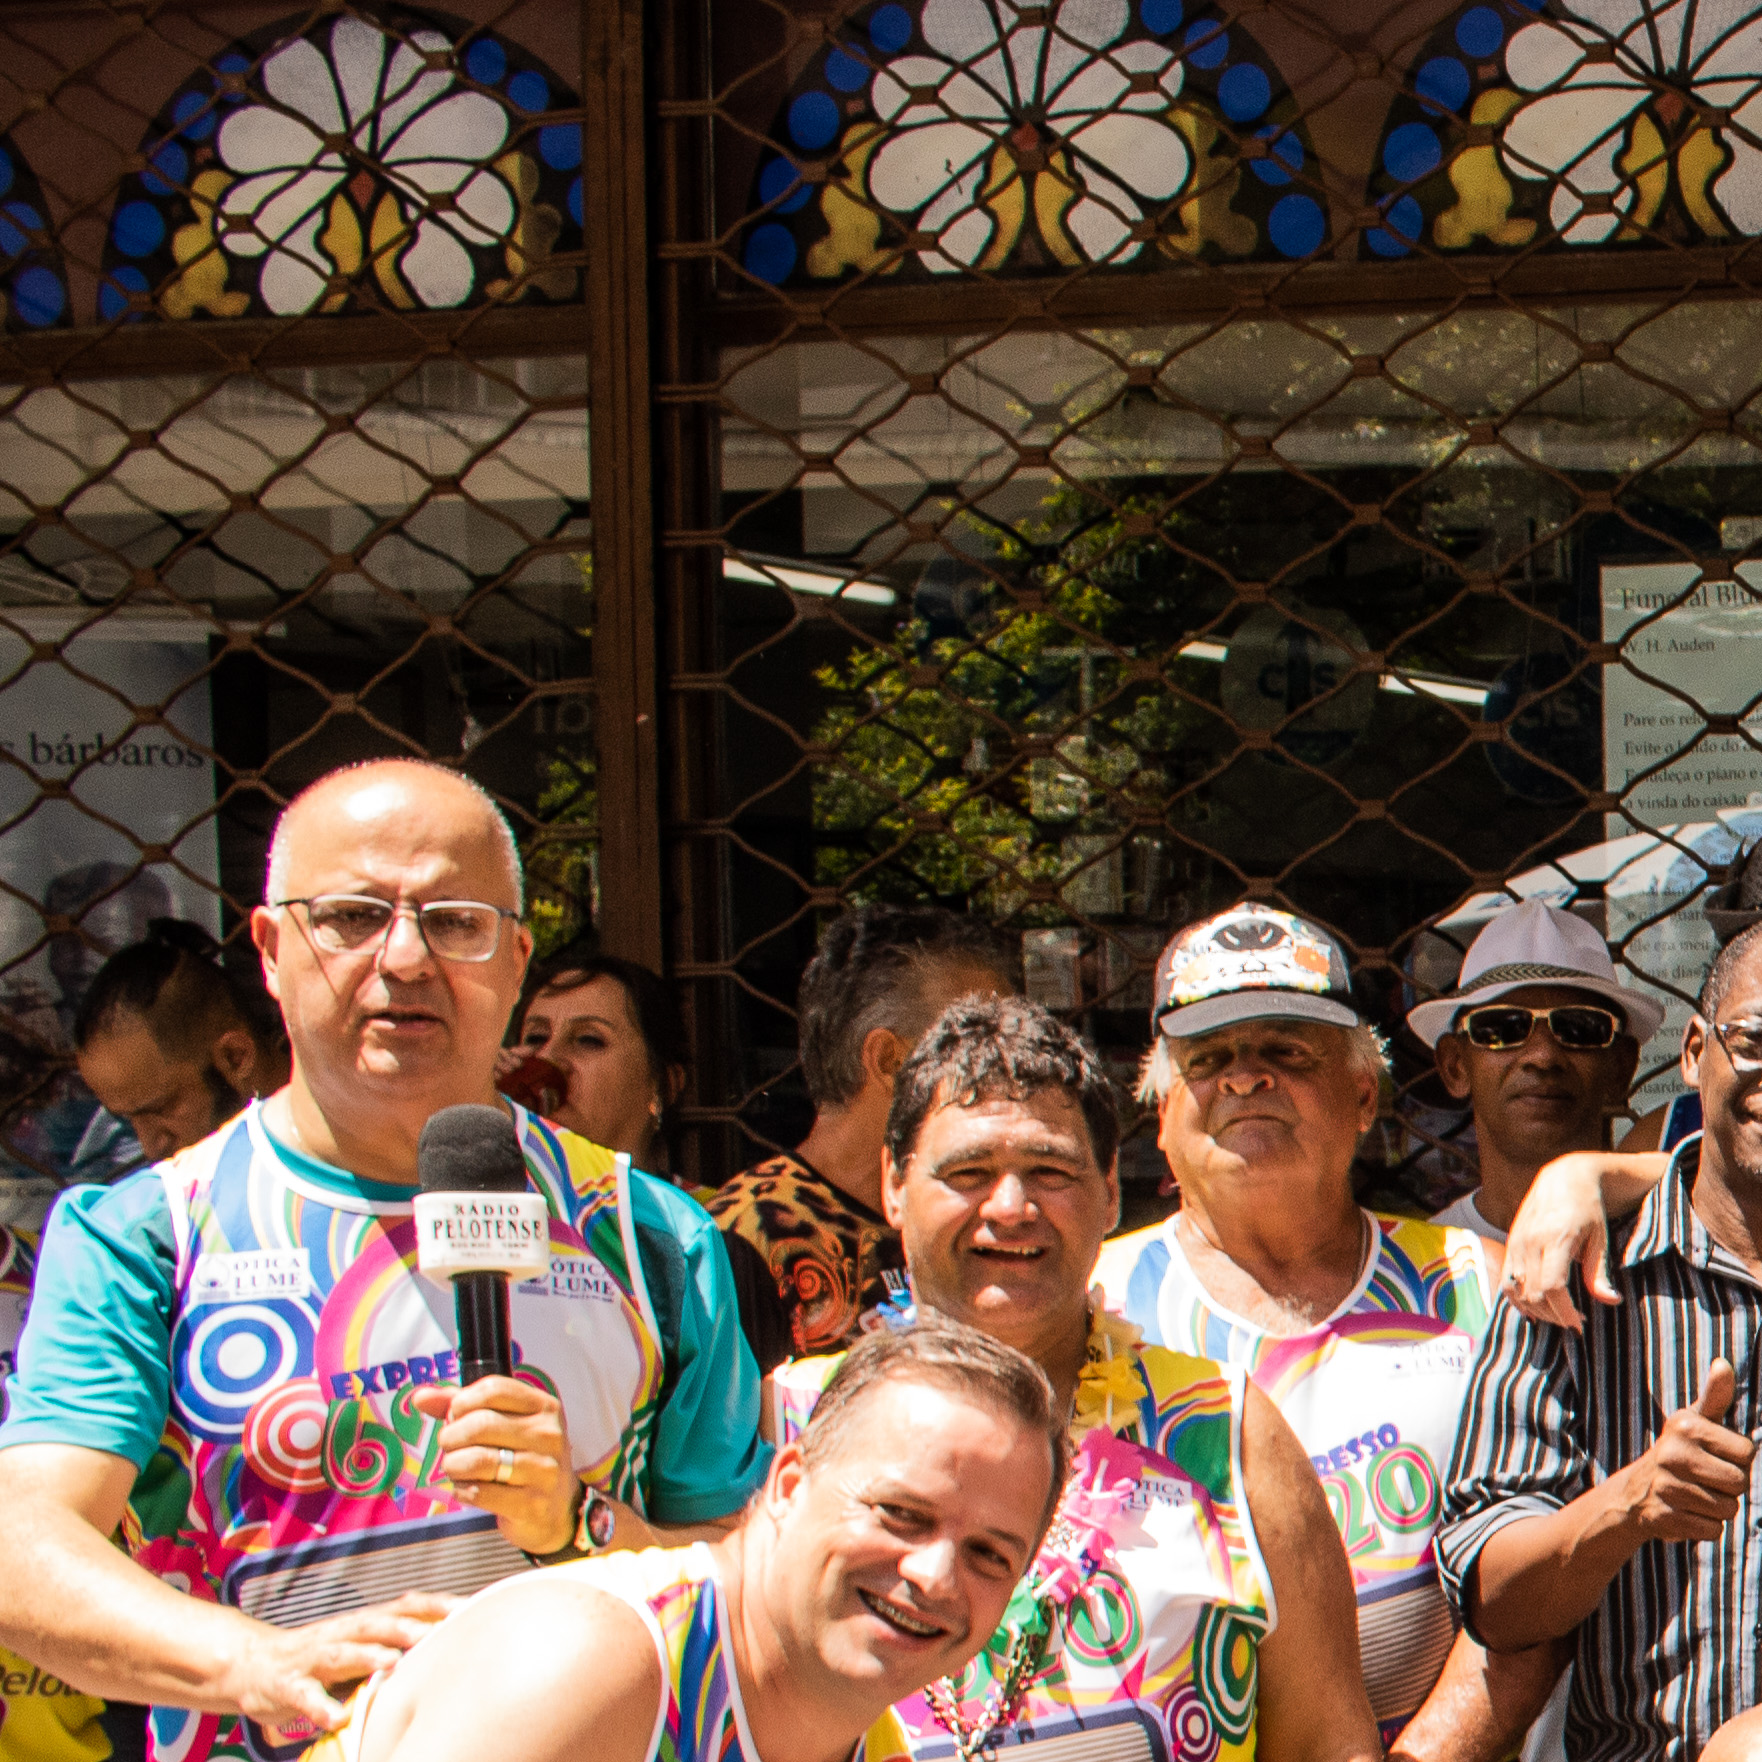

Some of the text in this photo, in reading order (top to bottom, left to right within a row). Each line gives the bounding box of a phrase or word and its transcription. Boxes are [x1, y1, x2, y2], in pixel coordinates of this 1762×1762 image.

[1622, 583, 1708, 610] Funeal
[433, 1219, 542, 1240] PELOTENSE
[329, 1339, 523, 1400] EXPRE
[1311, 1422, 1400, 1478] RESSO
[1320, 1442, 1441, 1558] 20
